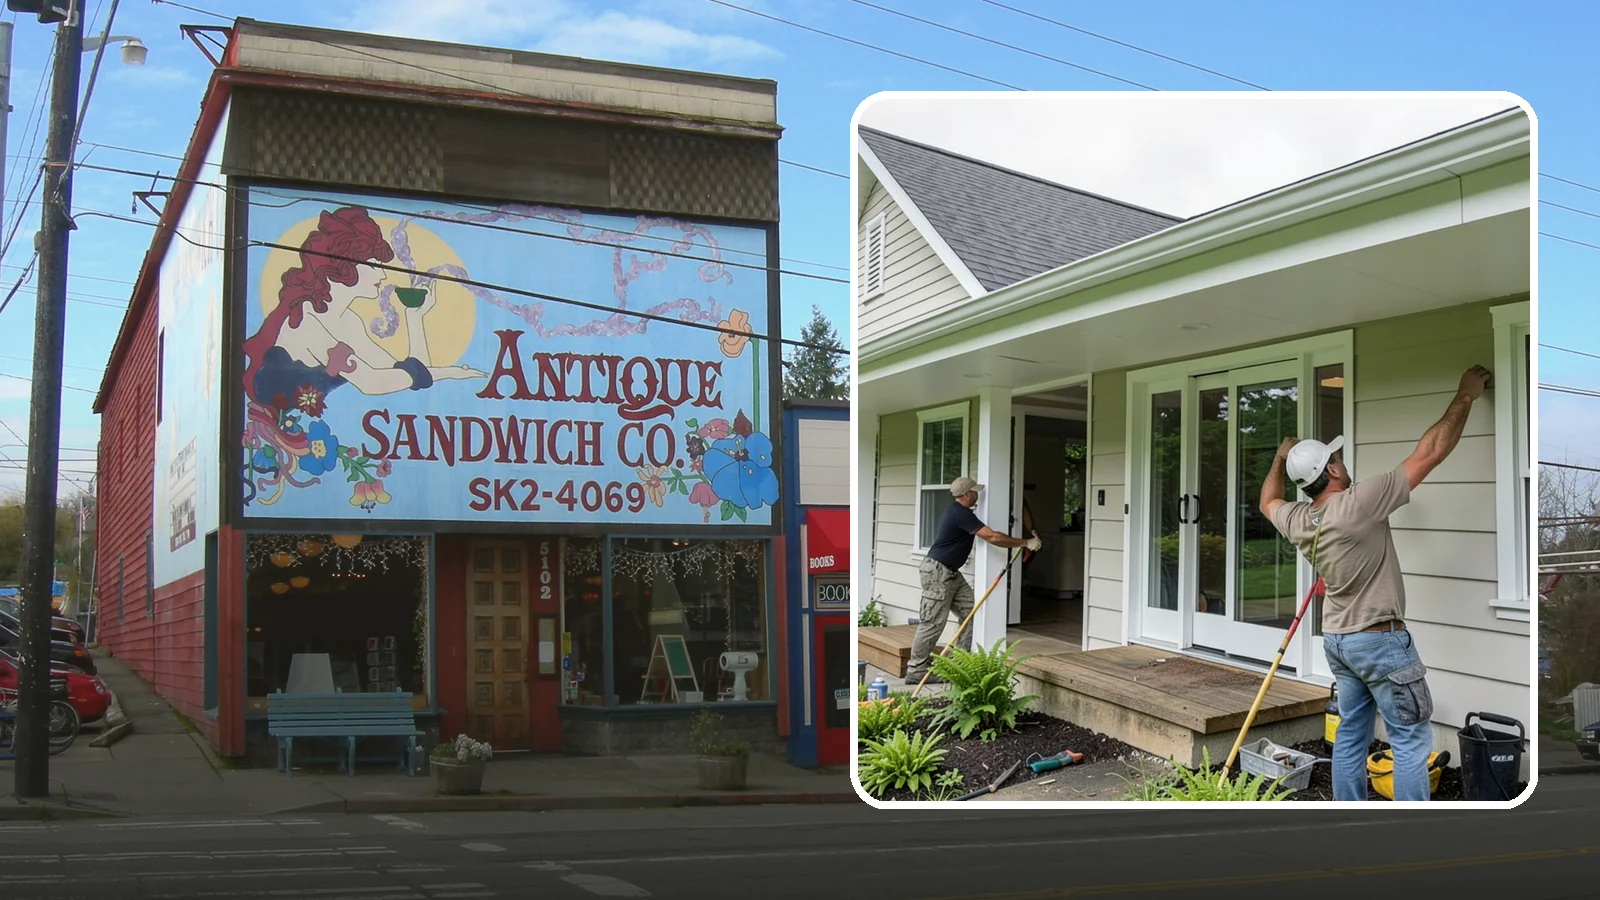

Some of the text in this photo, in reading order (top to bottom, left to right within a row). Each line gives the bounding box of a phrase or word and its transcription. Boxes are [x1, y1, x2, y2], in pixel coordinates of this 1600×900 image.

[475, 328, 724, 421] ANTIQUE
[361, 408, 685, 469] SANDWICH CO.
[468, 476, 646, 514] SK2-4069
[539, 541, 552, 600] 5102
[809, 555, 835, 569] BOOKS
